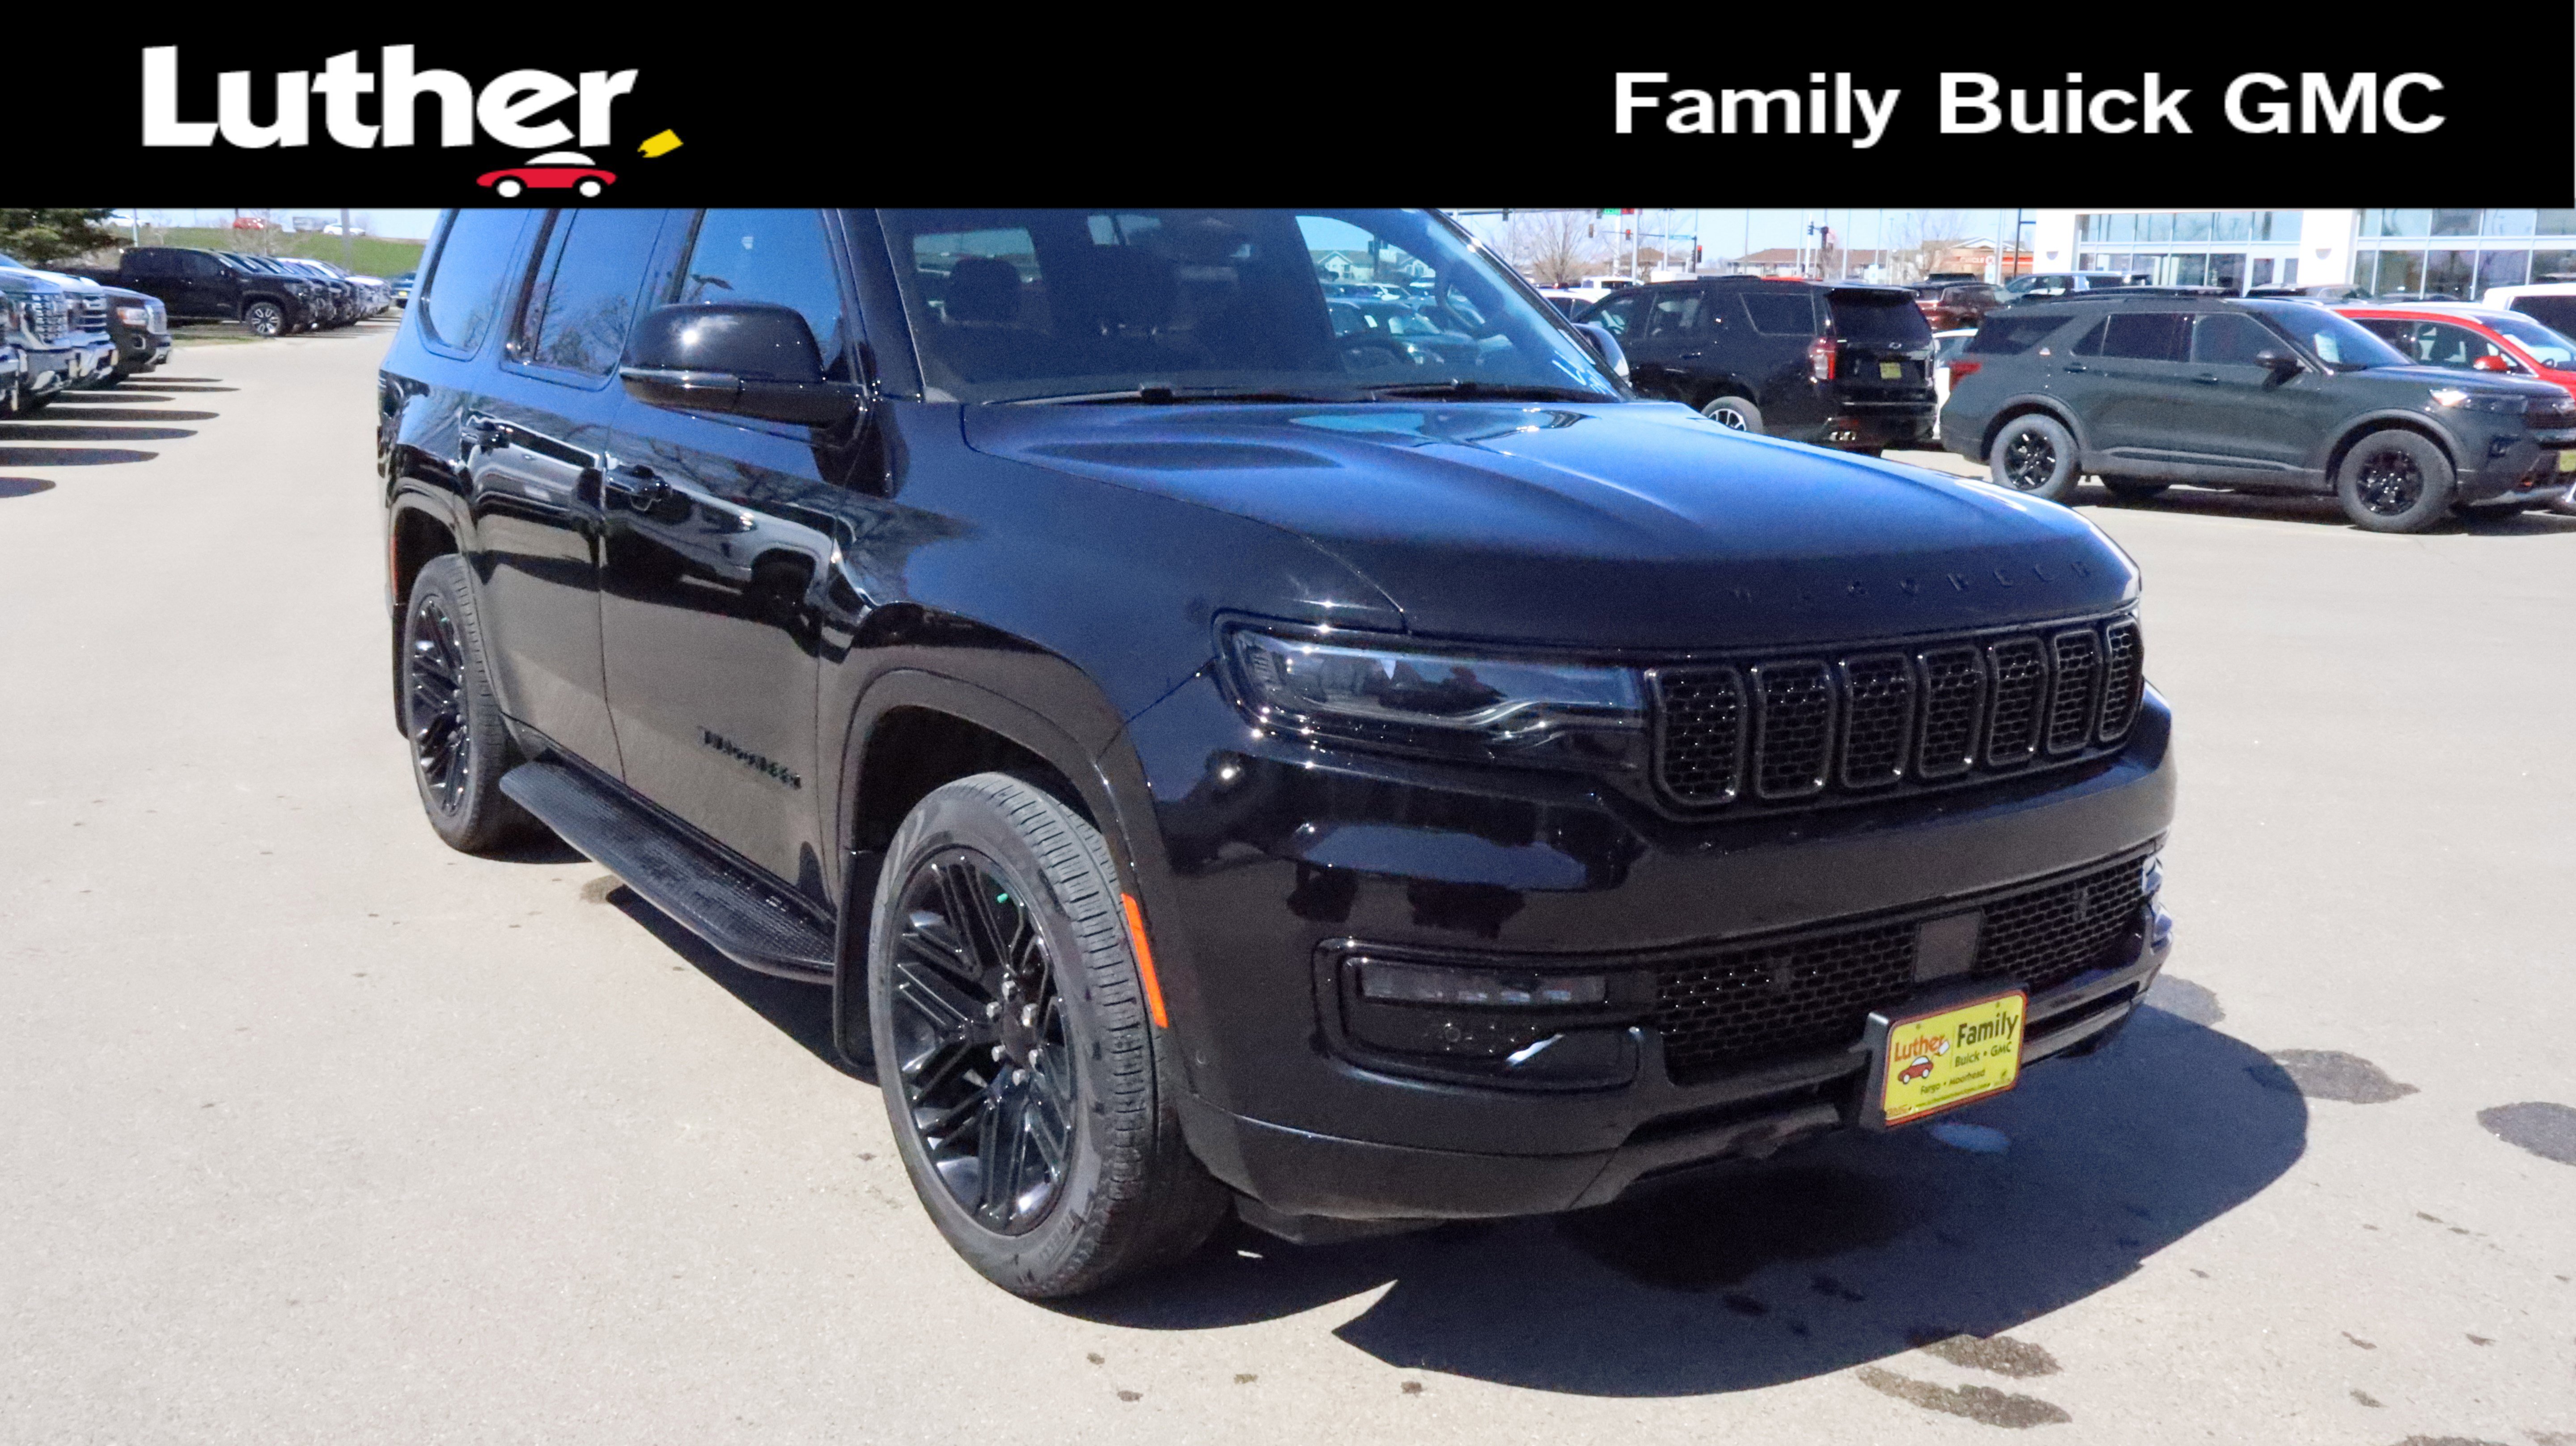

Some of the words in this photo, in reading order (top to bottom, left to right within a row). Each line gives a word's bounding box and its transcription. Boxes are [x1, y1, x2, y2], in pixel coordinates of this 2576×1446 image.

[1957, 1011, 2019, 1048] Family
[1894, 1034, 1945, 1062] Luther
[1955, 1051, 1980, 1067] Buick
[1990, 1041, 2012, 1057] GMC
